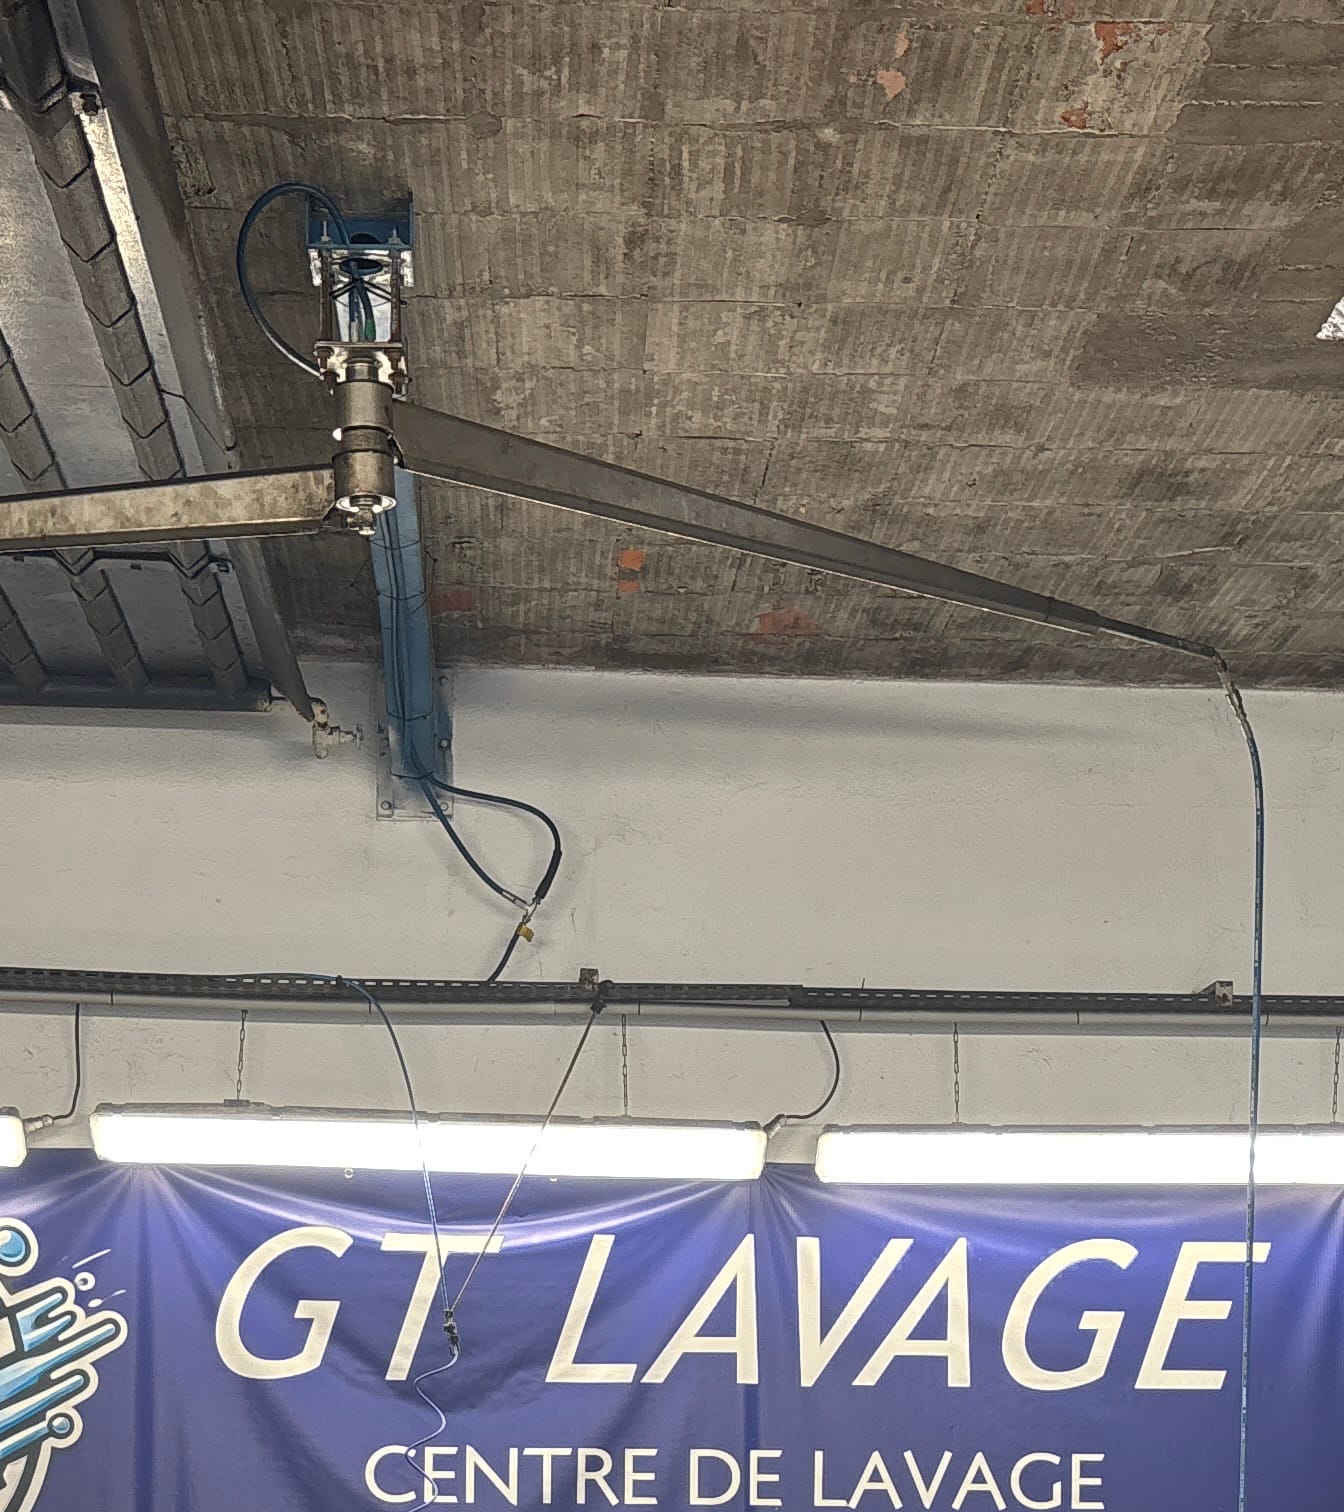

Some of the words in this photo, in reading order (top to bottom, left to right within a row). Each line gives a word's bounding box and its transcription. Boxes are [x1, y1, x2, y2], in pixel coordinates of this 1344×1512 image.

[215, 1225, 505, 1381] GT
[545, 1233, 1272, 1391] LAVAGE
[364, 1444, 659, 1507] CENTRE
[689, 1448, 783, 1507] DE
[813, 1450, 1105, 1511] LAVAGE
